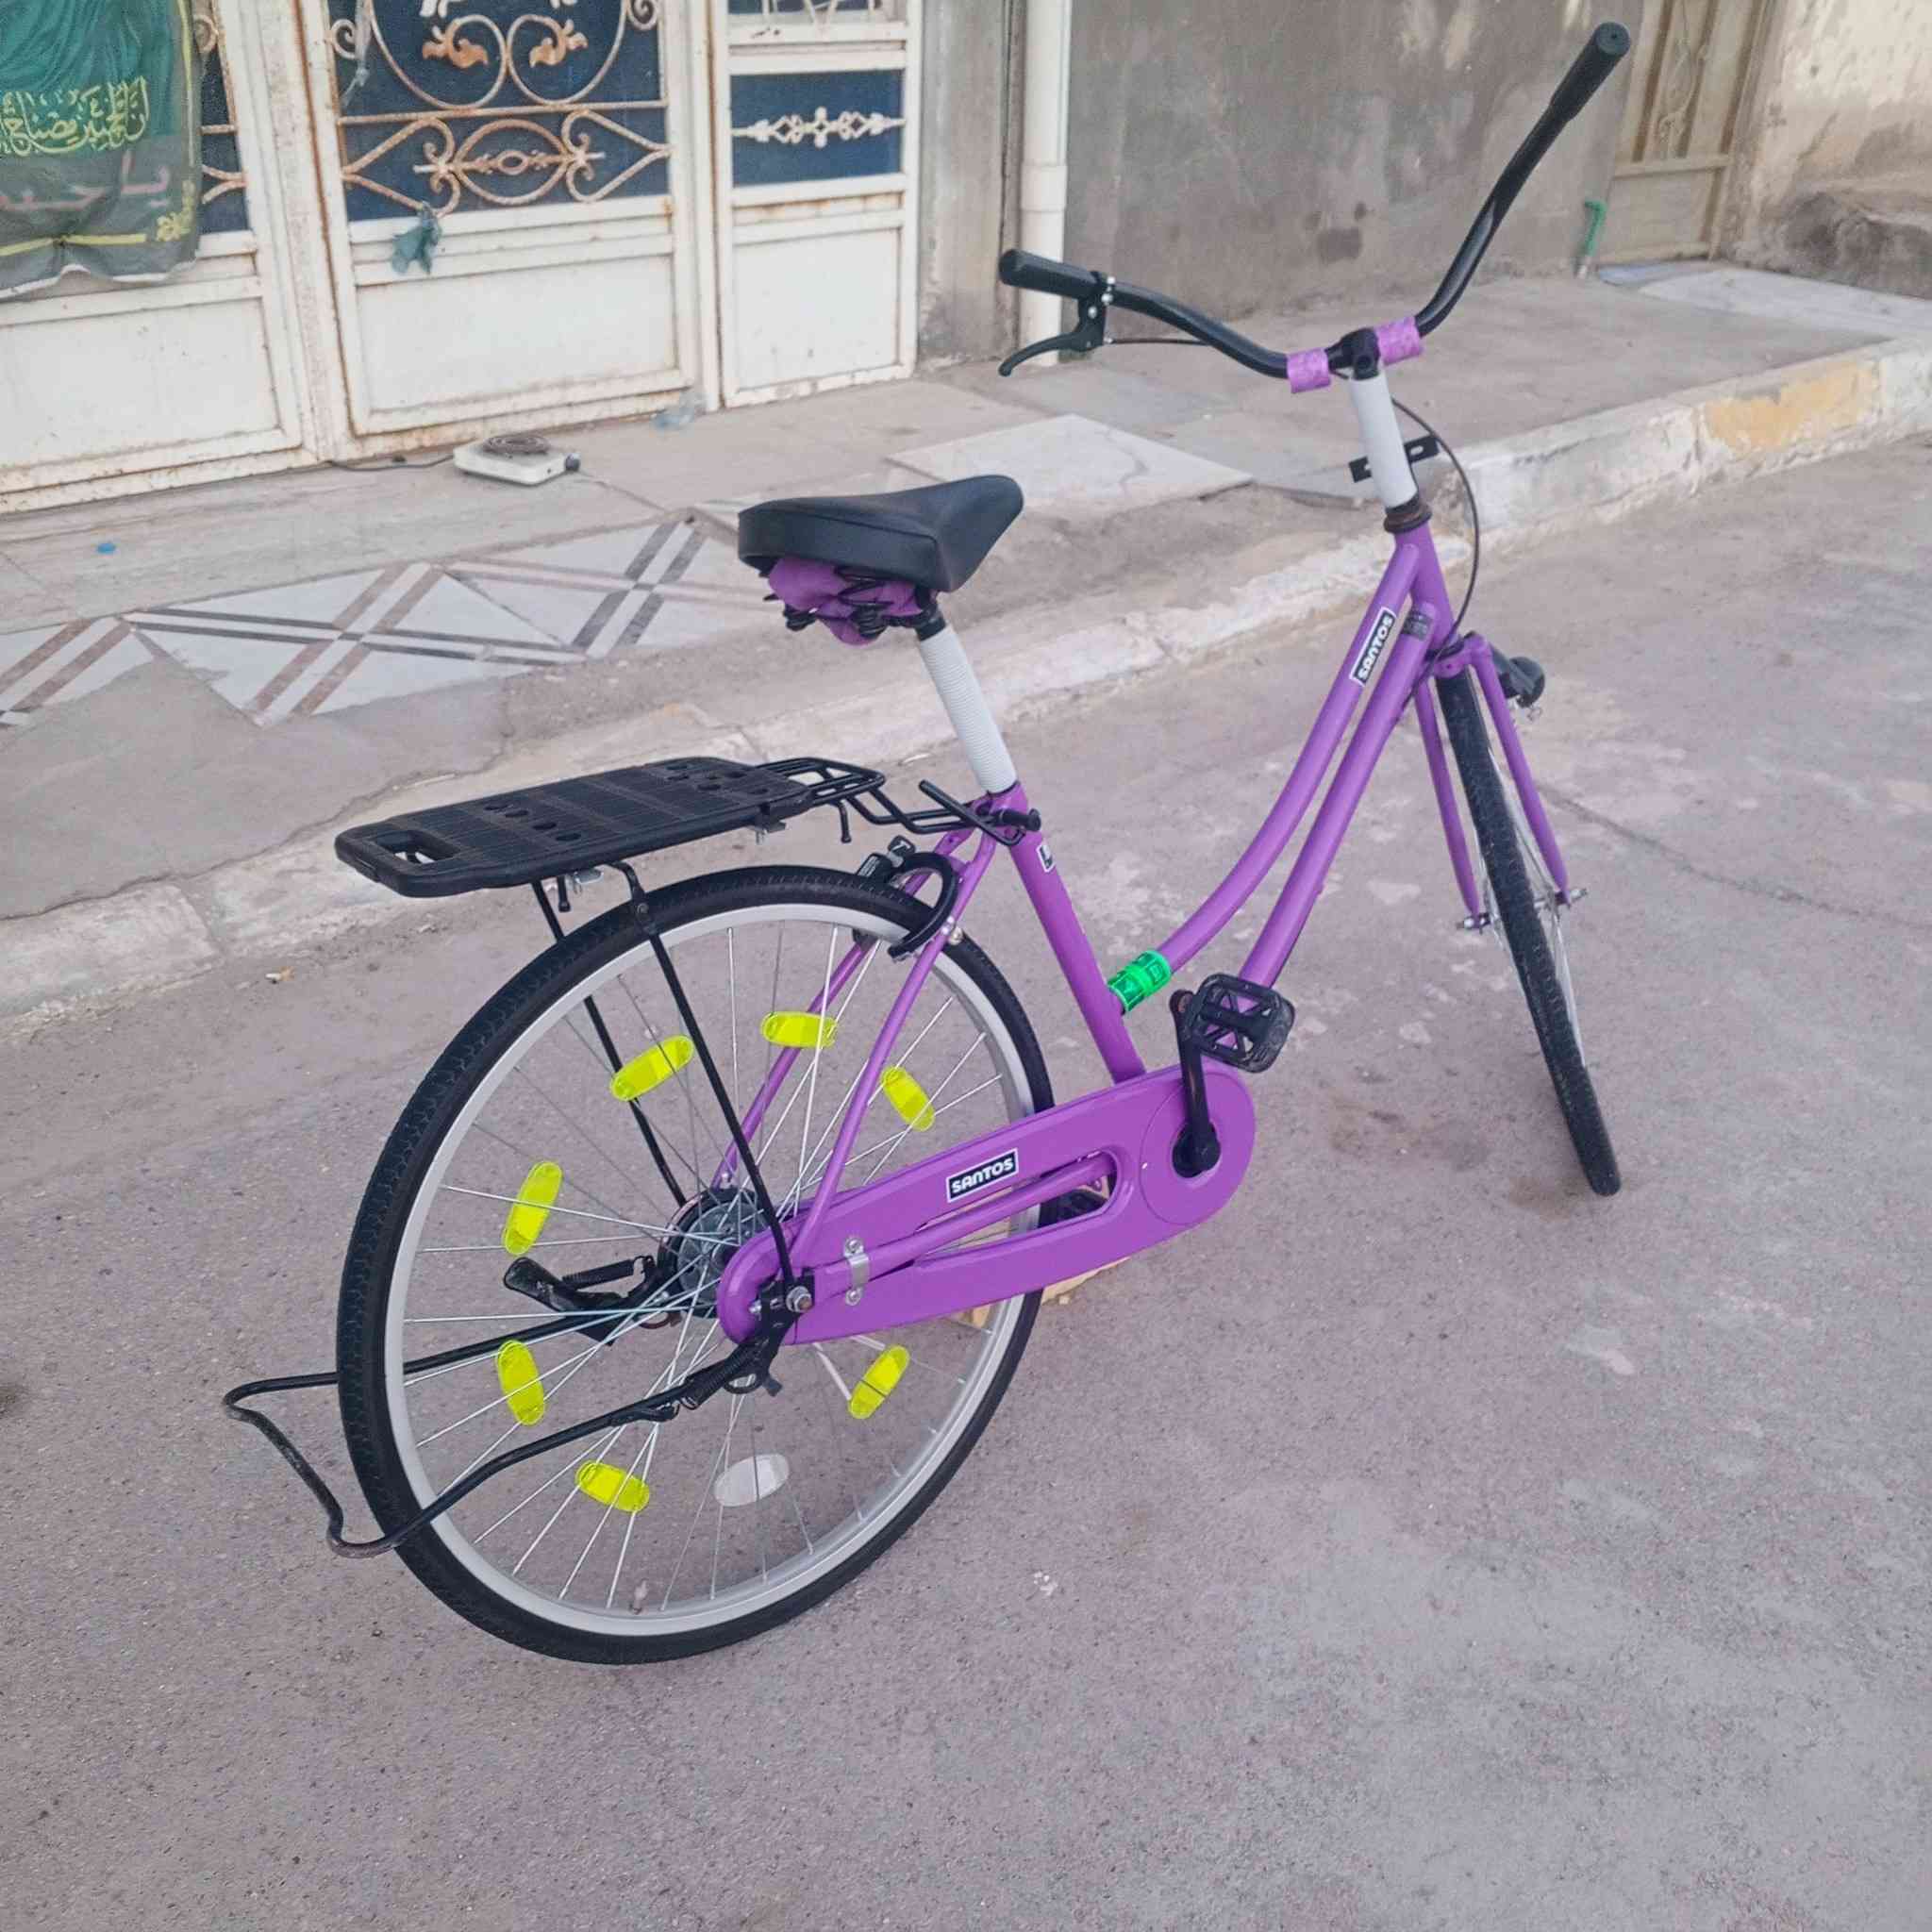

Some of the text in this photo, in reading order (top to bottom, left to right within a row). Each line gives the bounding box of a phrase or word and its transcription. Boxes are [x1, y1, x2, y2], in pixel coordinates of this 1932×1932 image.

[121, 148, 171, 208] يا
[1357, 614, 1393, 680] SANTOS
[951, 1157, 1014, 1193] SANTOS
